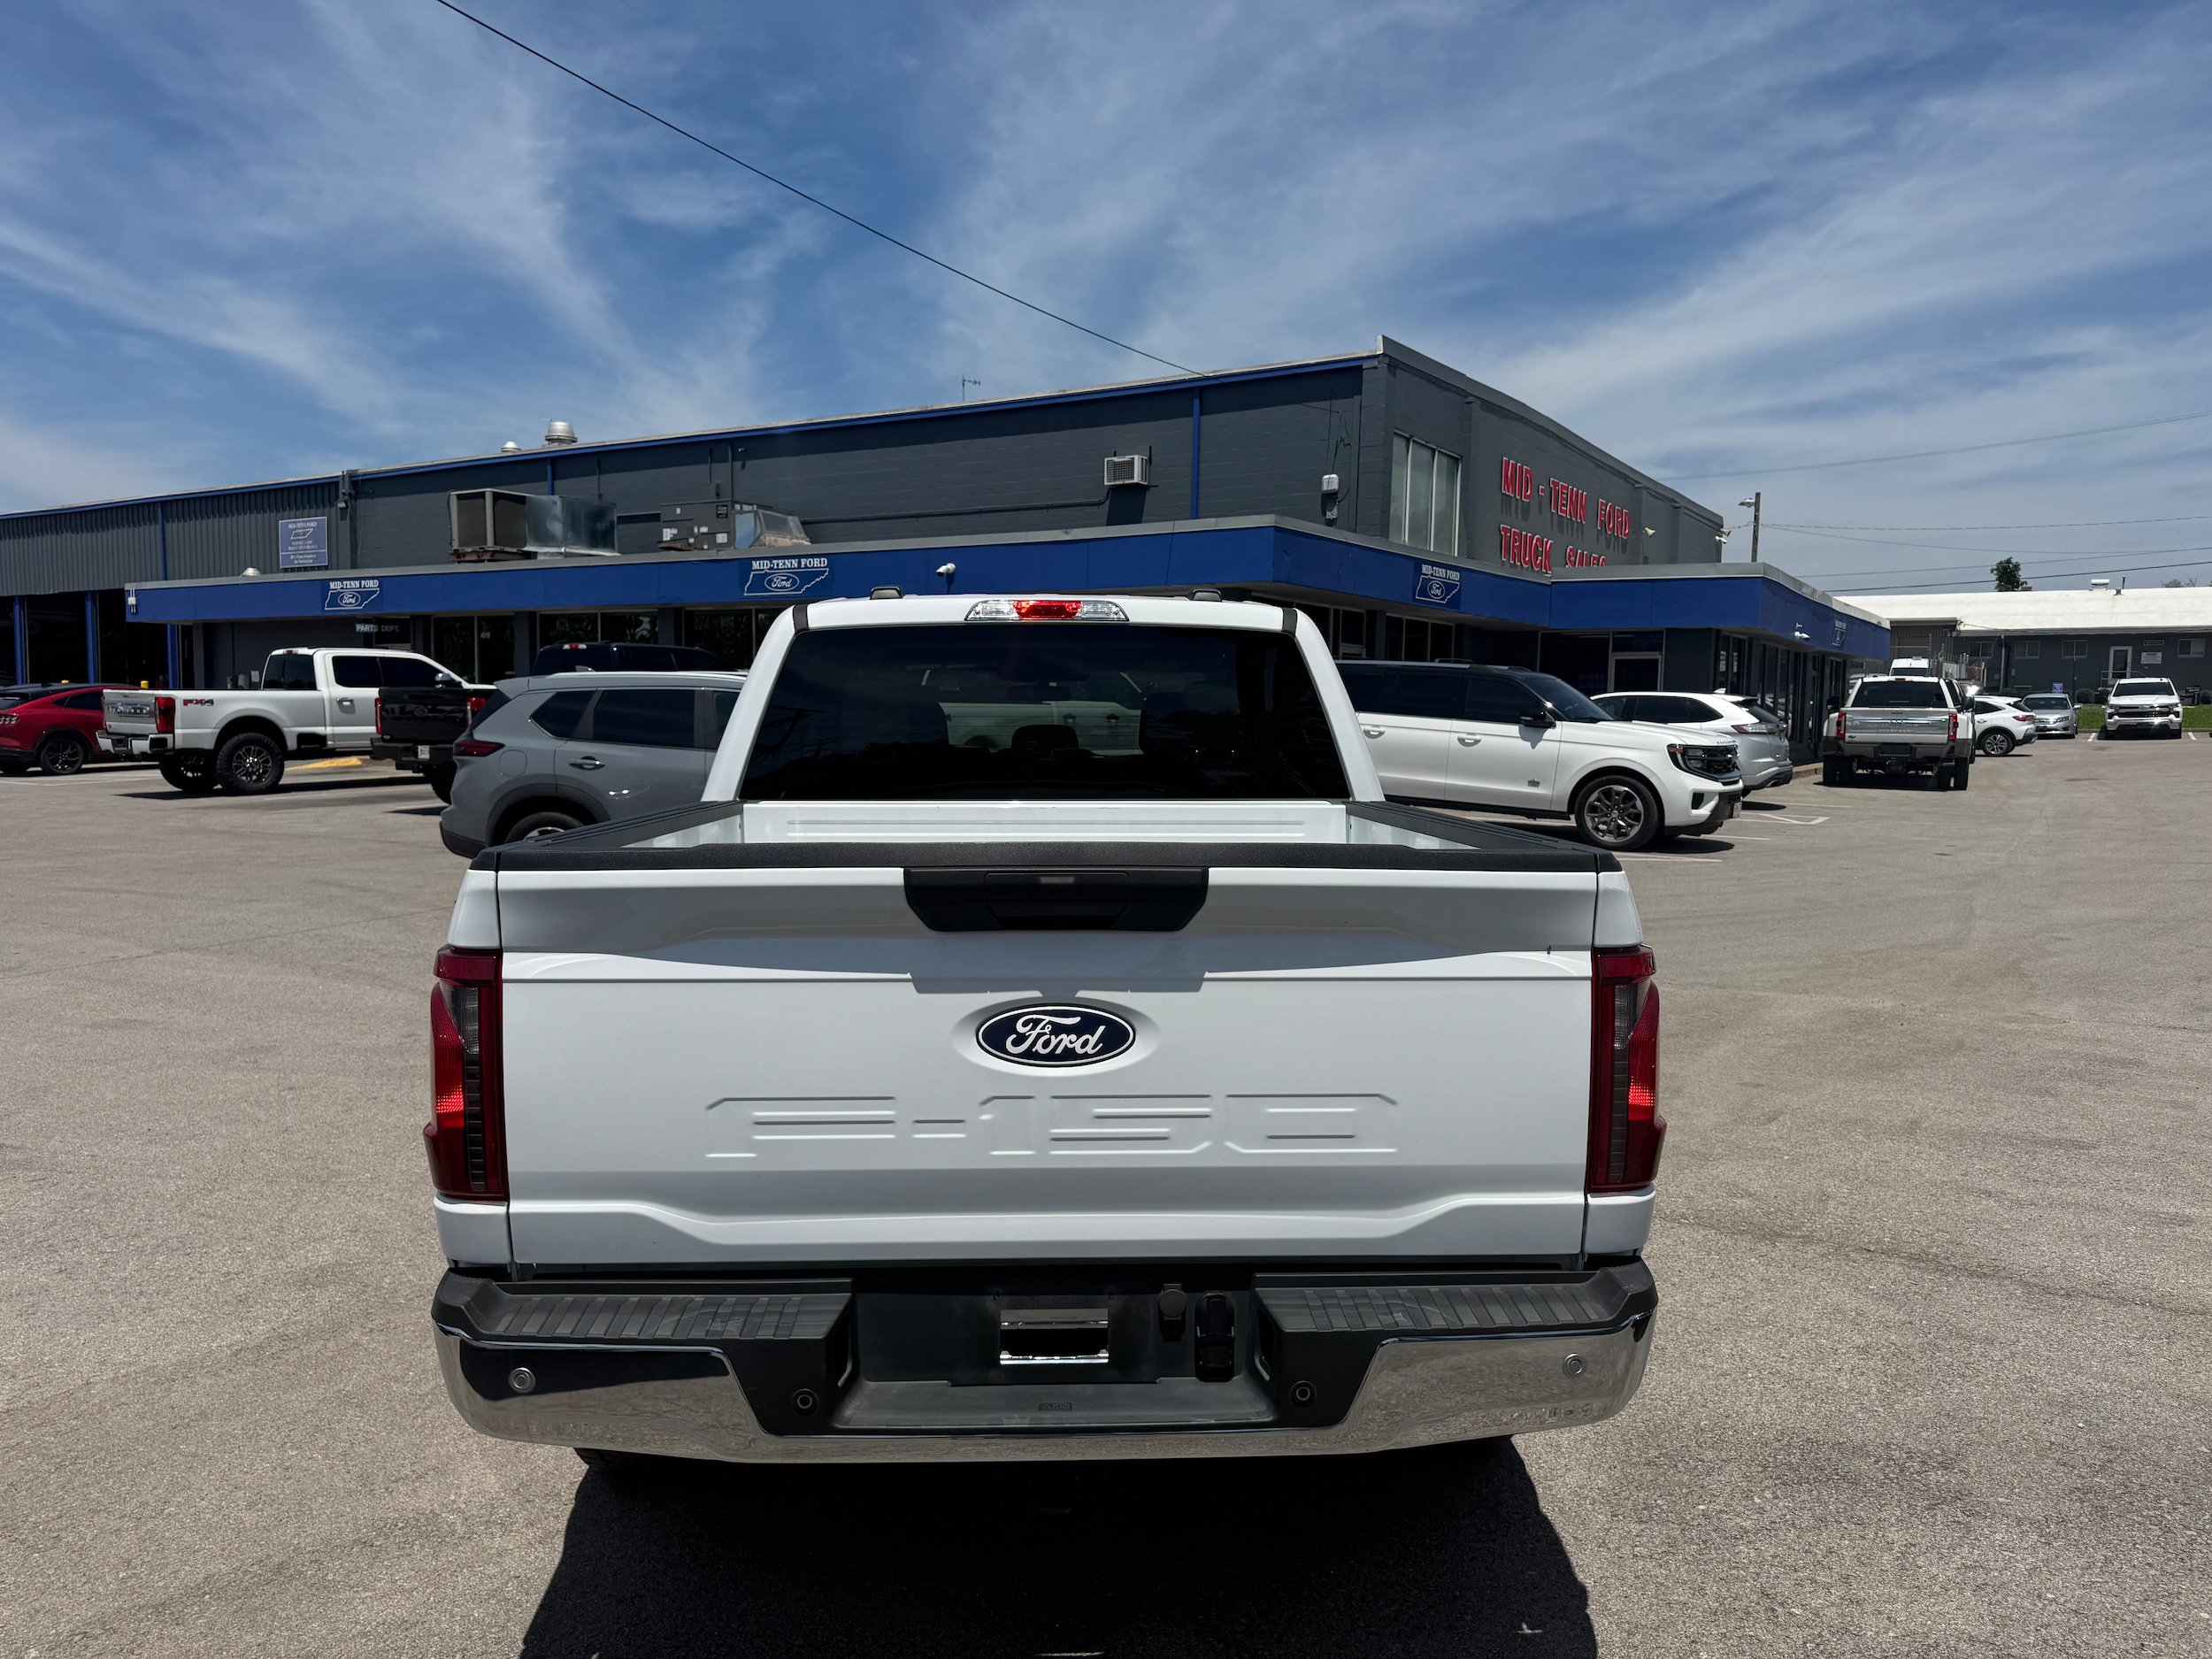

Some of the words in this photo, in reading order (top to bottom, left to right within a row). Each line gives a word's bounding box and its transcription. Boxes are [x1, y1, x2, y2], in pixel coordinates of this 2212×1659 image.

[1502, 457, 1534, 503] MID
[1550, 478, 1587, 524] TENN
[1597, 499, 1632, 539] FORD
[1501, 525, 1553, 573] TRUCK
[751, 558, 798, 570] MID-TENN
[801, 557, 827, 567] FORD
[1422, 564, 1446, 578] MID-TENN
[1447, 569, 1460, 580] FORD
[329, 580, 359, 589] MID-TENN
[361, 580, 380, 588] FORD
[771, 575, 793, 588] Ford
[355, 623, 379, 632] PARTS
[1006, 1014, 1105, 1056] Ford
[706, 1094, 1399, 1157] F-150
